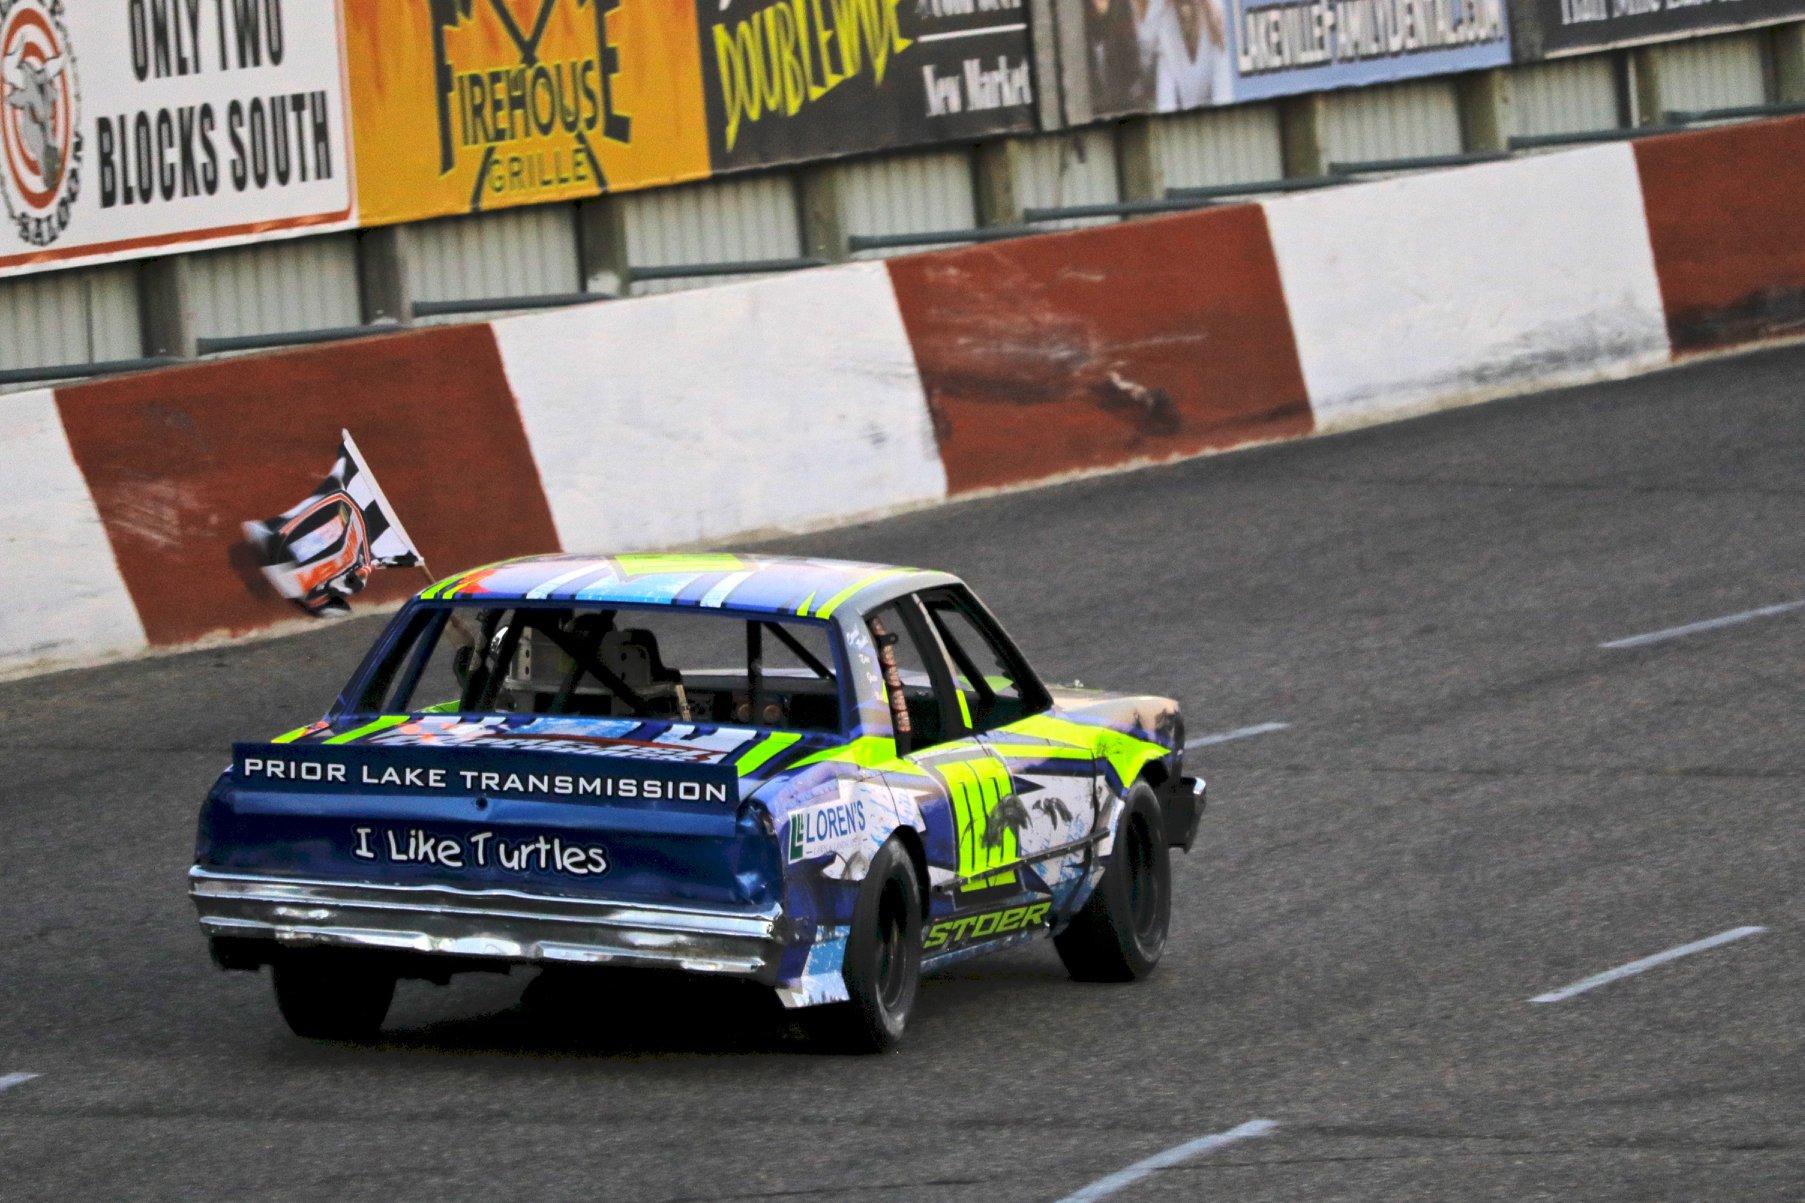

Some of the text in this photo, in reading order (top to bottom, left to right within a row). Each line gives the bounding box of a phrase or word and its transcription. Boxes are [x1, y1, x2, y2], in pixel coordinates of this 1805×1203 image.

[96, 90, 333, 209] BLOCKS SOUTH
[488, 147, 589, 194] GRILLE
[243, 757, 728, 803] PRIOR LAKE TRANSMISSION
[806, 799, 866, 844] LOREN'S
[355, 827, 607, 876] I Like Turtles
[922, 901, 1051, 949] STOER
